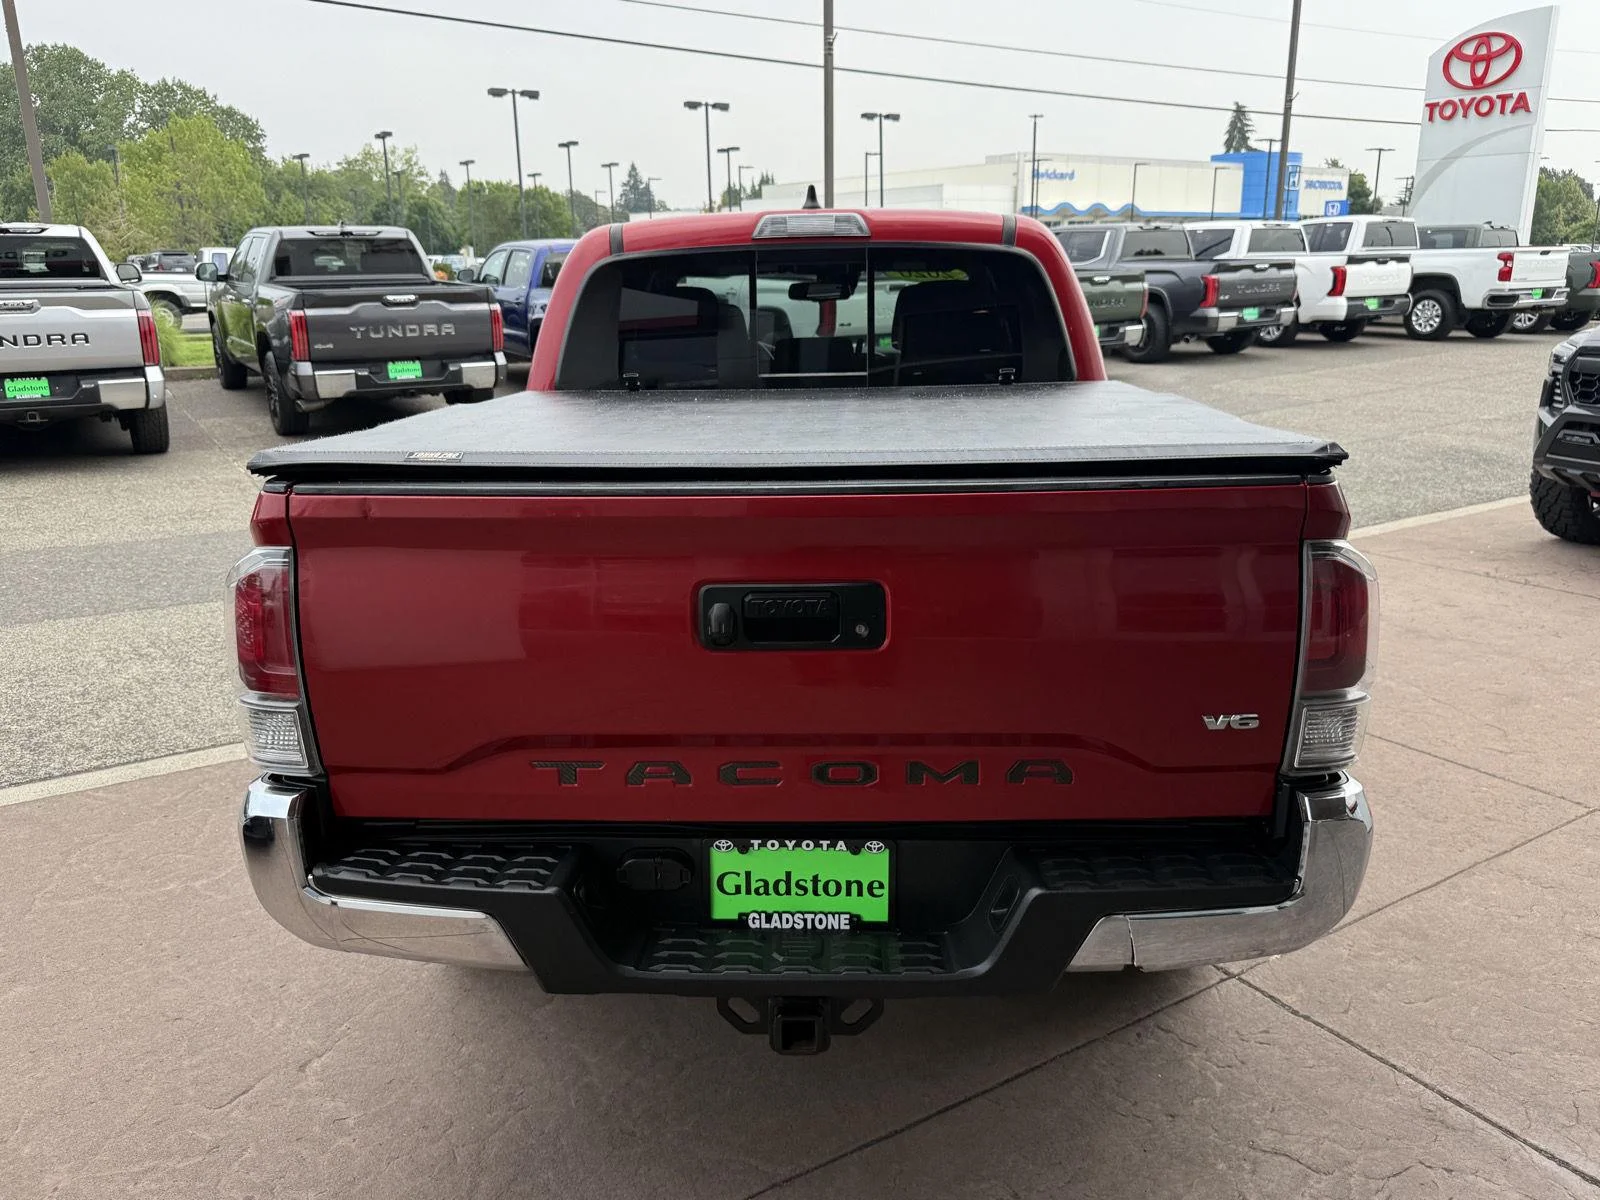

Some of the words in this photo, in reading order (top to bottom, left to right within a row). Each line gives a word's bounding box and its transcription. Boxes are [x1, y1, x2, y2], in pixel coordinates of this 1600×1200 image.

[1425, 92, 1532, 123] TOYOTA
[1304, 180, 1343, 190] HONDA
[350, 323, 456, 339] TUNDRA
[0, 333, 90, 348] NDRA
[7, 384, 49, 393] Gladstone
[1202, 714, 1259, 730] V6
[529, 759, 1075, 786] TACOMA
[751, 840, 847, 851] TOYOTA
[716, 871, 885, 898] Gladstone
[748, 912, 851, 930] GLADSTONE
